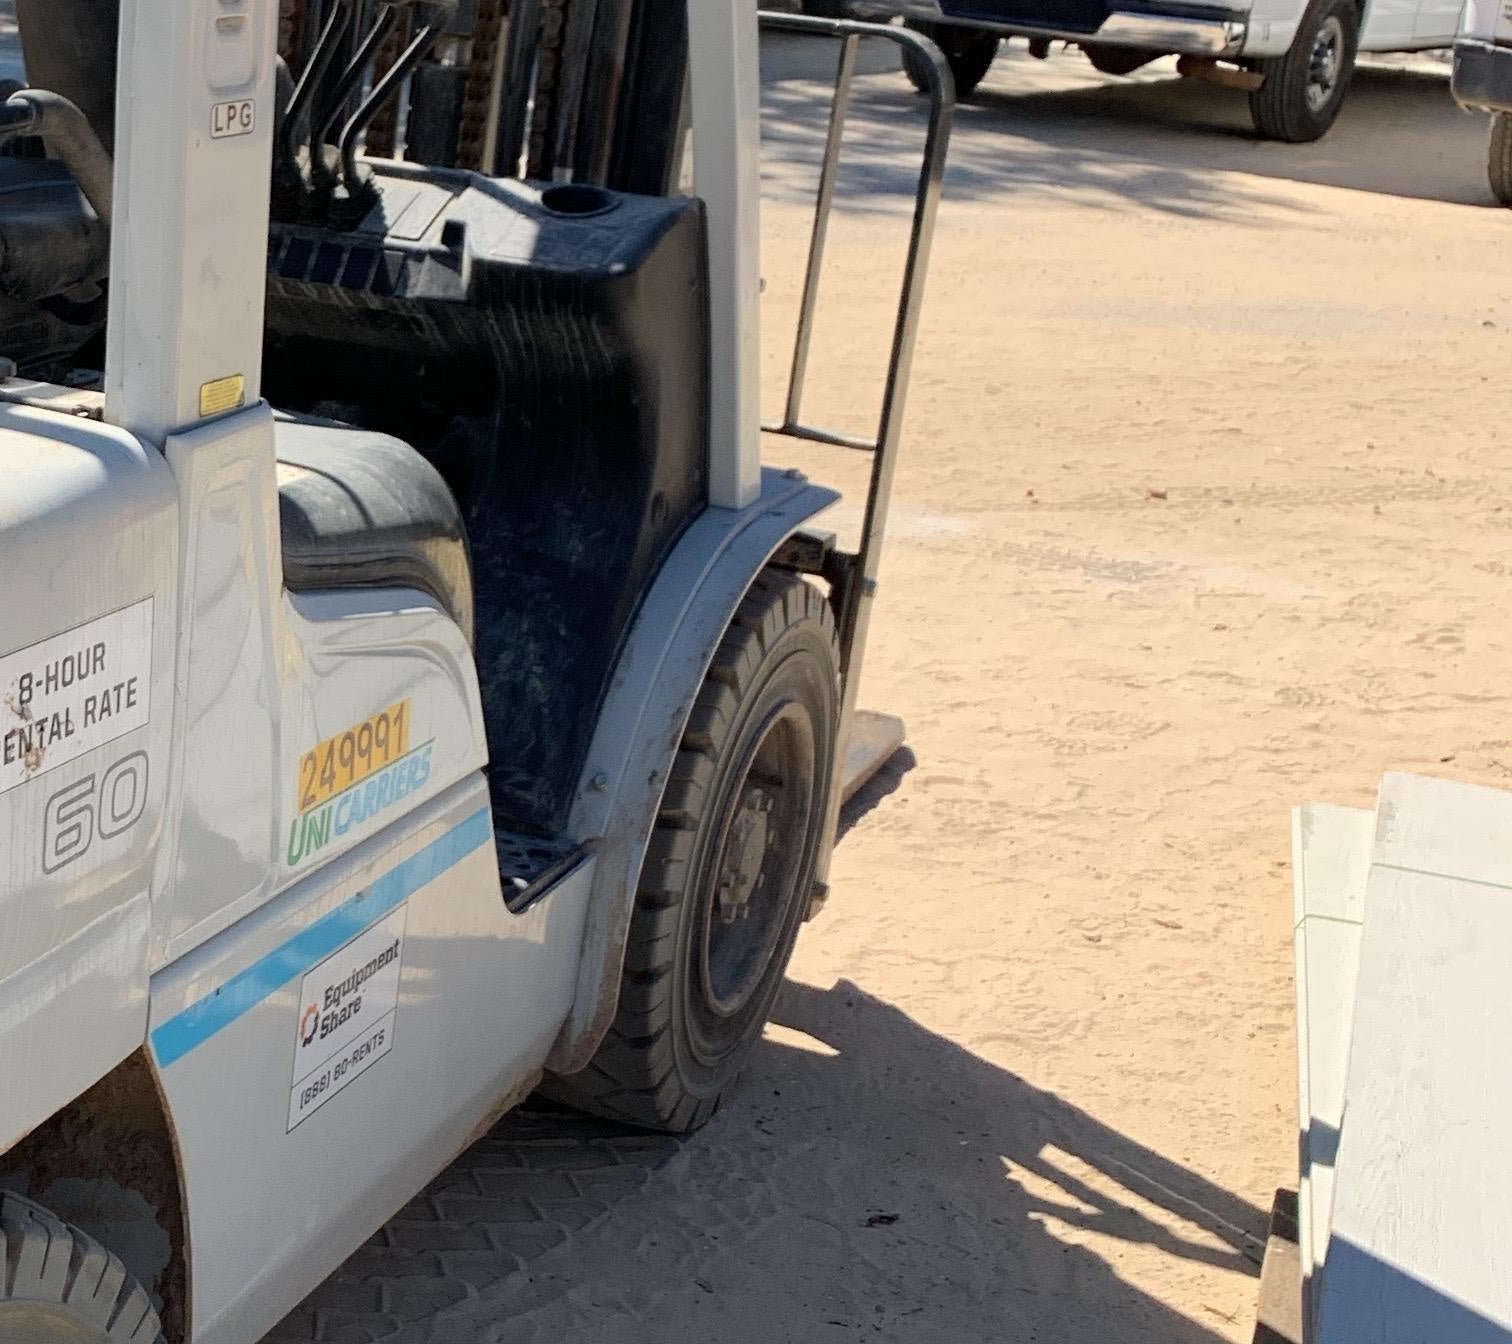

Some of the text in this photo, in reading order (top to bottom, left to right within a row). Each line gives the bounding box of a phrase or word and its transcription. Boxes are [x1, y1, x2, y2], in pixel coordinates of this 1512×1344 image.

[215, 102, 251, 132] LPG
[18, 641, 106, 706] 8-HOUR
[84, 675, 138, 728] RATE
[300, 701, 405, 812] 249991
[42, 749, 150, 875] 60
[322, 937, 400, 1012] Equipment
[319, 995, 363, 1040] Share
[300, 1070, 331, 1110] (888)
